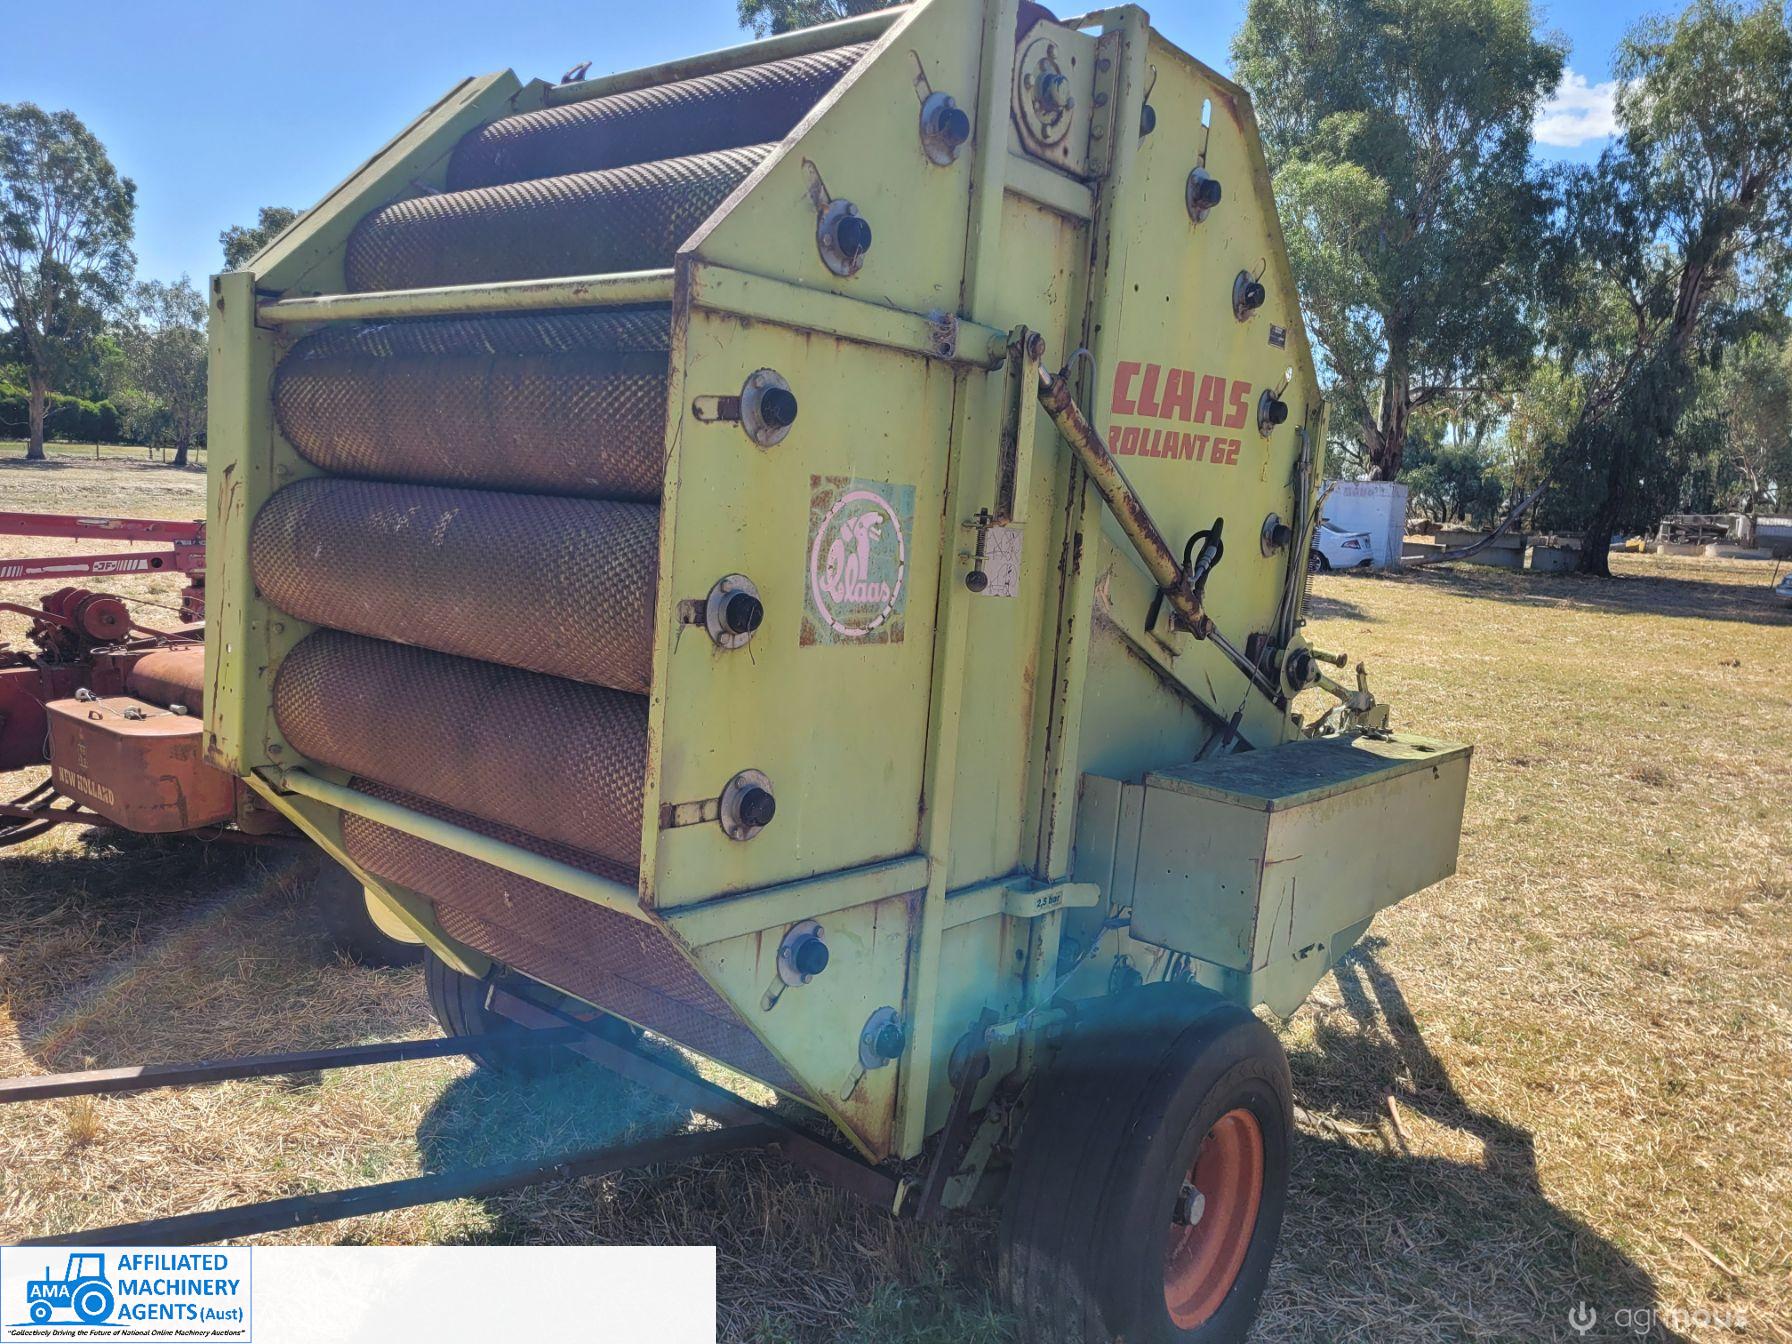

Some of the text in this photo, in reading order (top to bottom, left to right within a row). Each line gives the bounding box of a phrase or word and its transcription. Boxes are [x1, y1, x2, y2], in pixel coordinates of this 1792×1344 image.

[1111, 361, 1252, 429] CLAAS
[1108, 426, 1242, 465] ROLLANT 62
[59, 766, 115, 806] NEW HOLLAND
